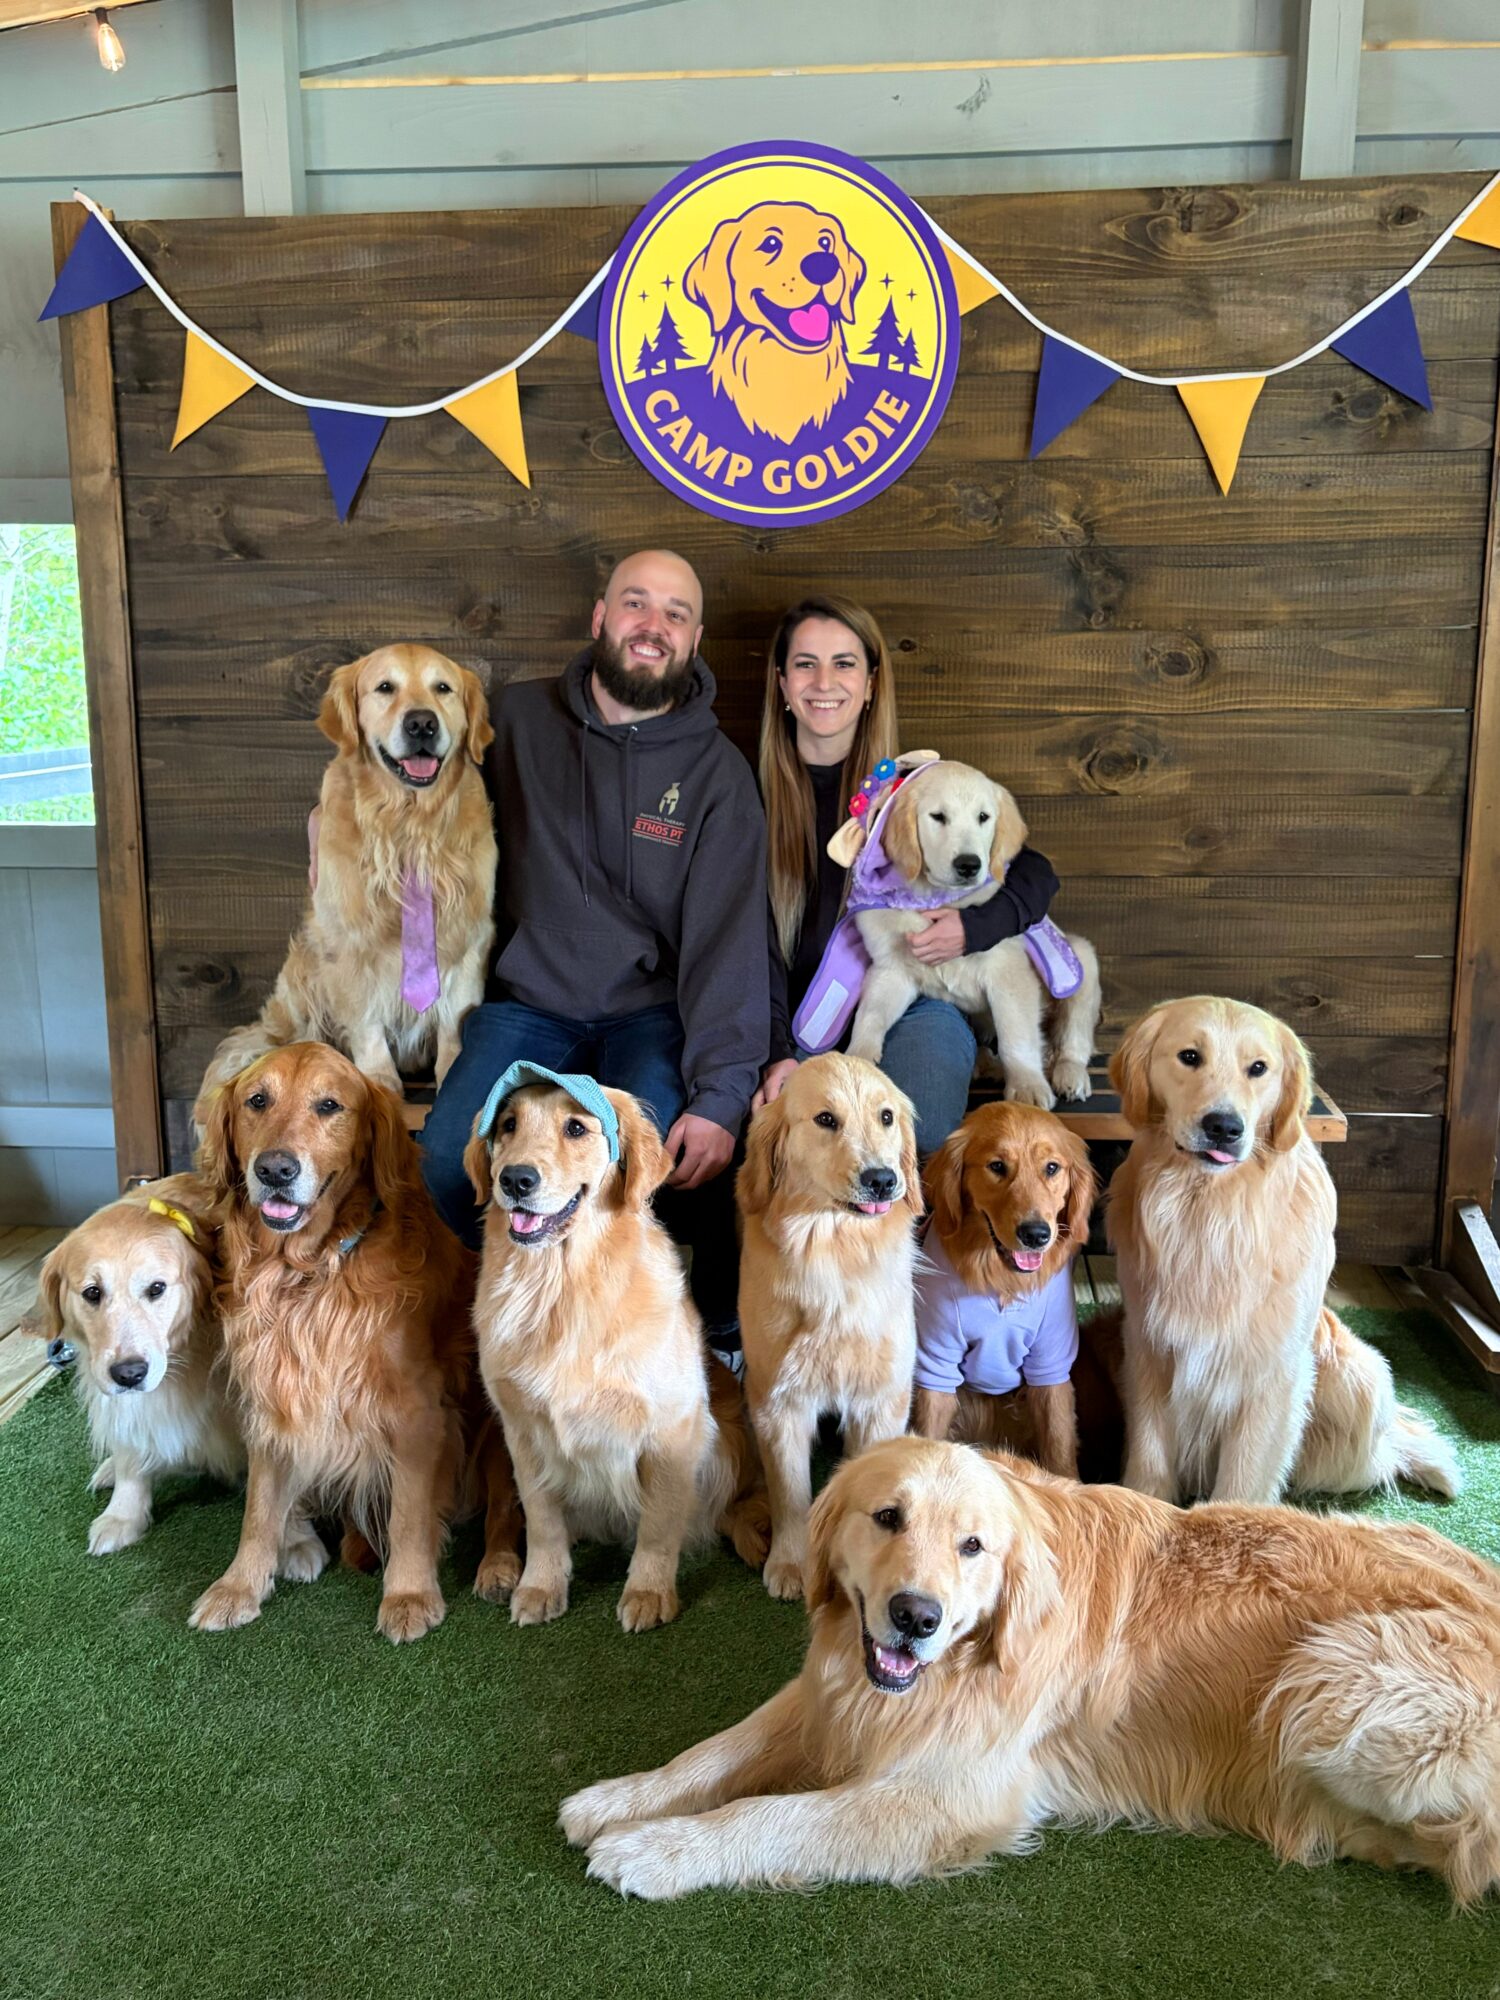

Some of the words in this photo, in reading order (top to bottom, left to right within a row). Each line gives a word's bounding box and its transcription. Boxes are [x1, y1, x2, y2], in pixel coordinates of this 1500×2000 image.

[644, 389, 753, 487] CAMP
[762, 389, 910, 495] GOLDIE
[635, 820, 669, 836] ETHOS
[669, 829, 684, 840] PT
